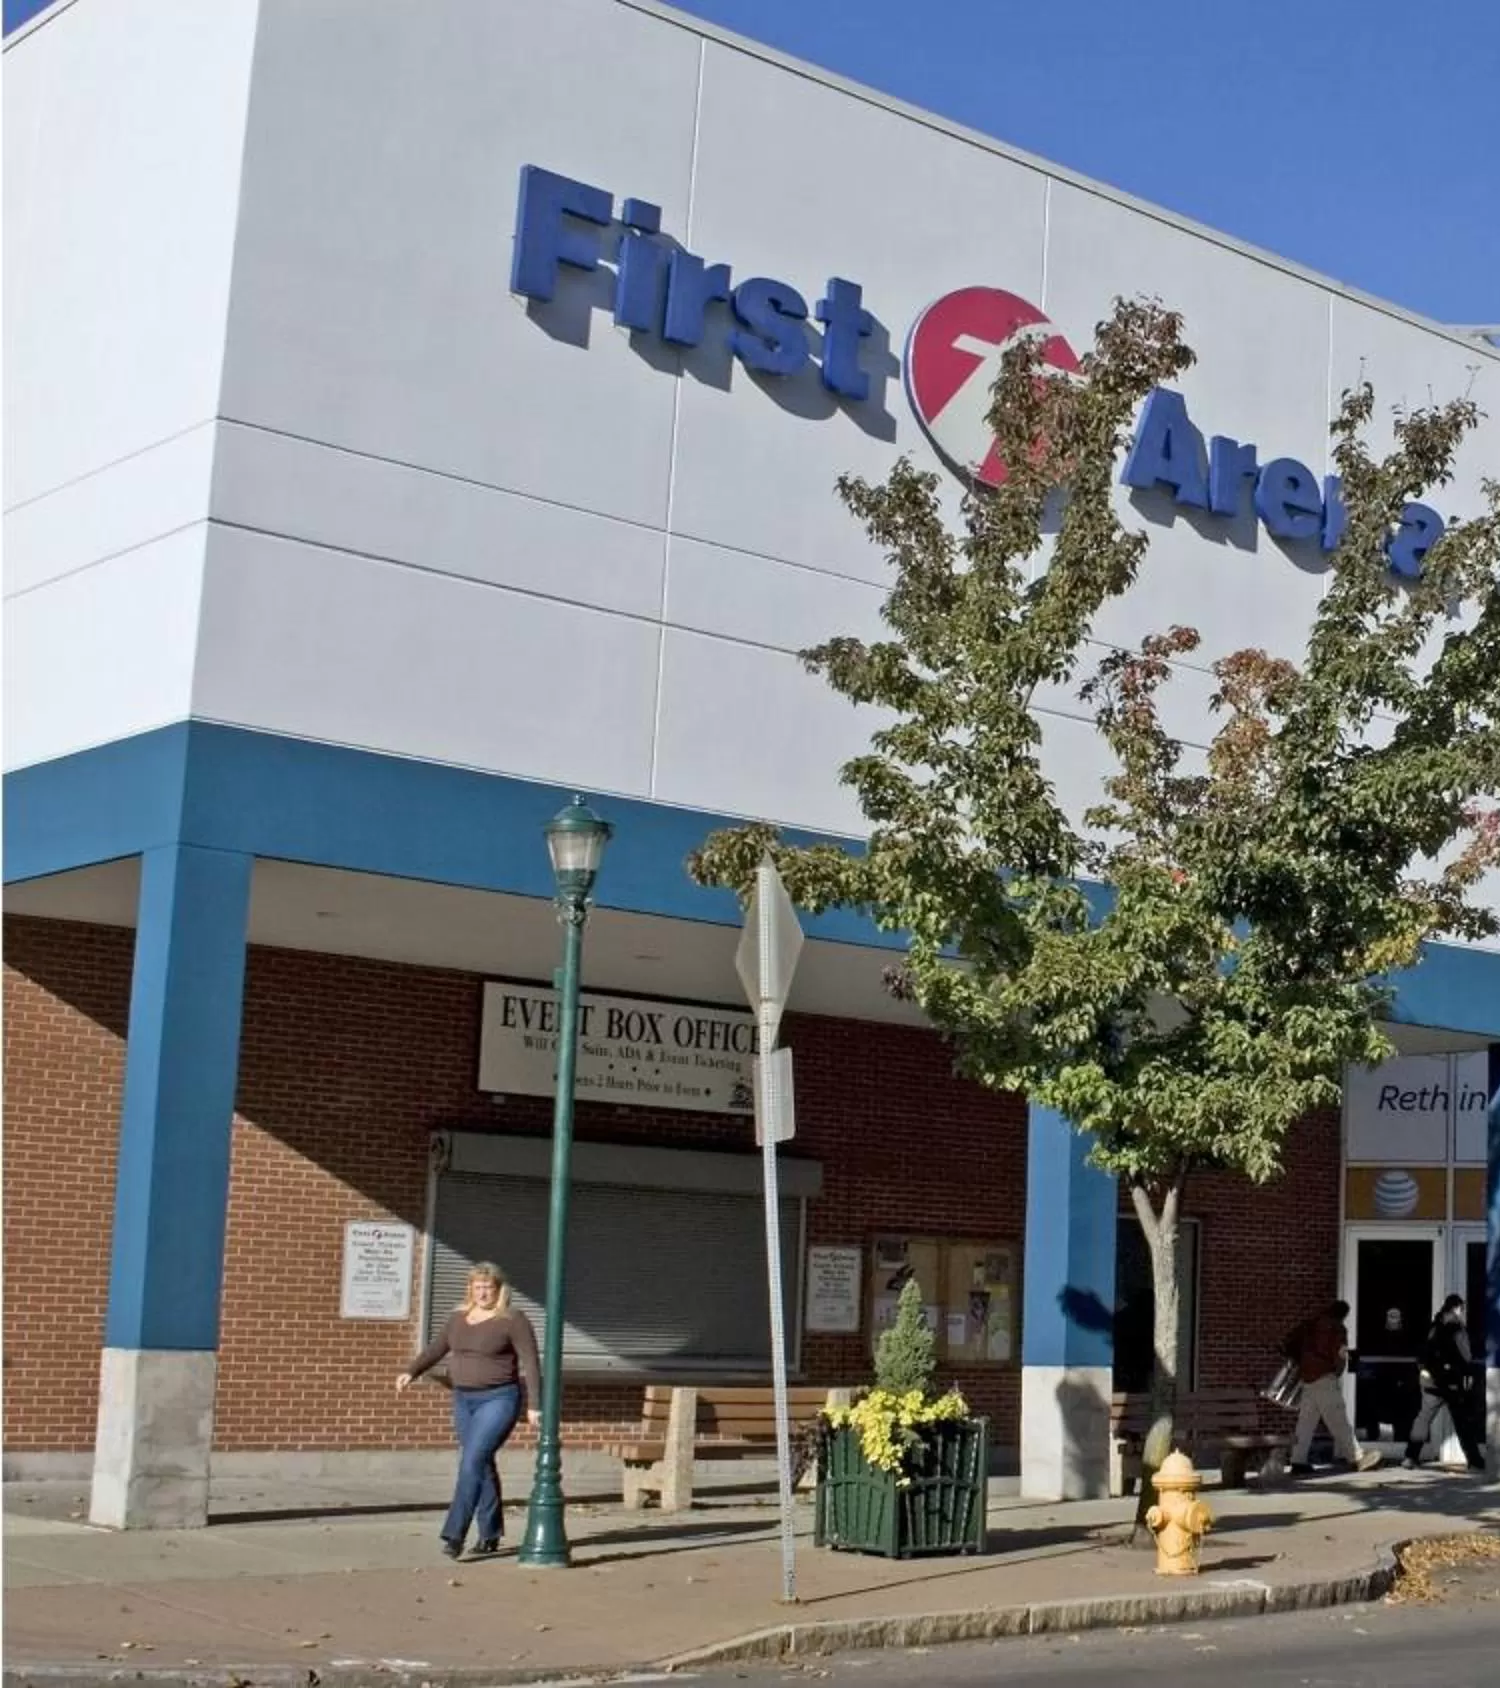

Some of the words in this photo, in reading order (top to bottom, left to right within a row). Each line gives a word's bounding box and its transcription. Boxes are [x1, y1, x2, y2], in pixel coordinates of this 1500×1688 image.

[511, 163, 872, 401] First
[501, 995, 595, 1036] EVET
[606, 1007, 664, 1045] BOX
[1377, 1083, 1489, 1113] Rethin
